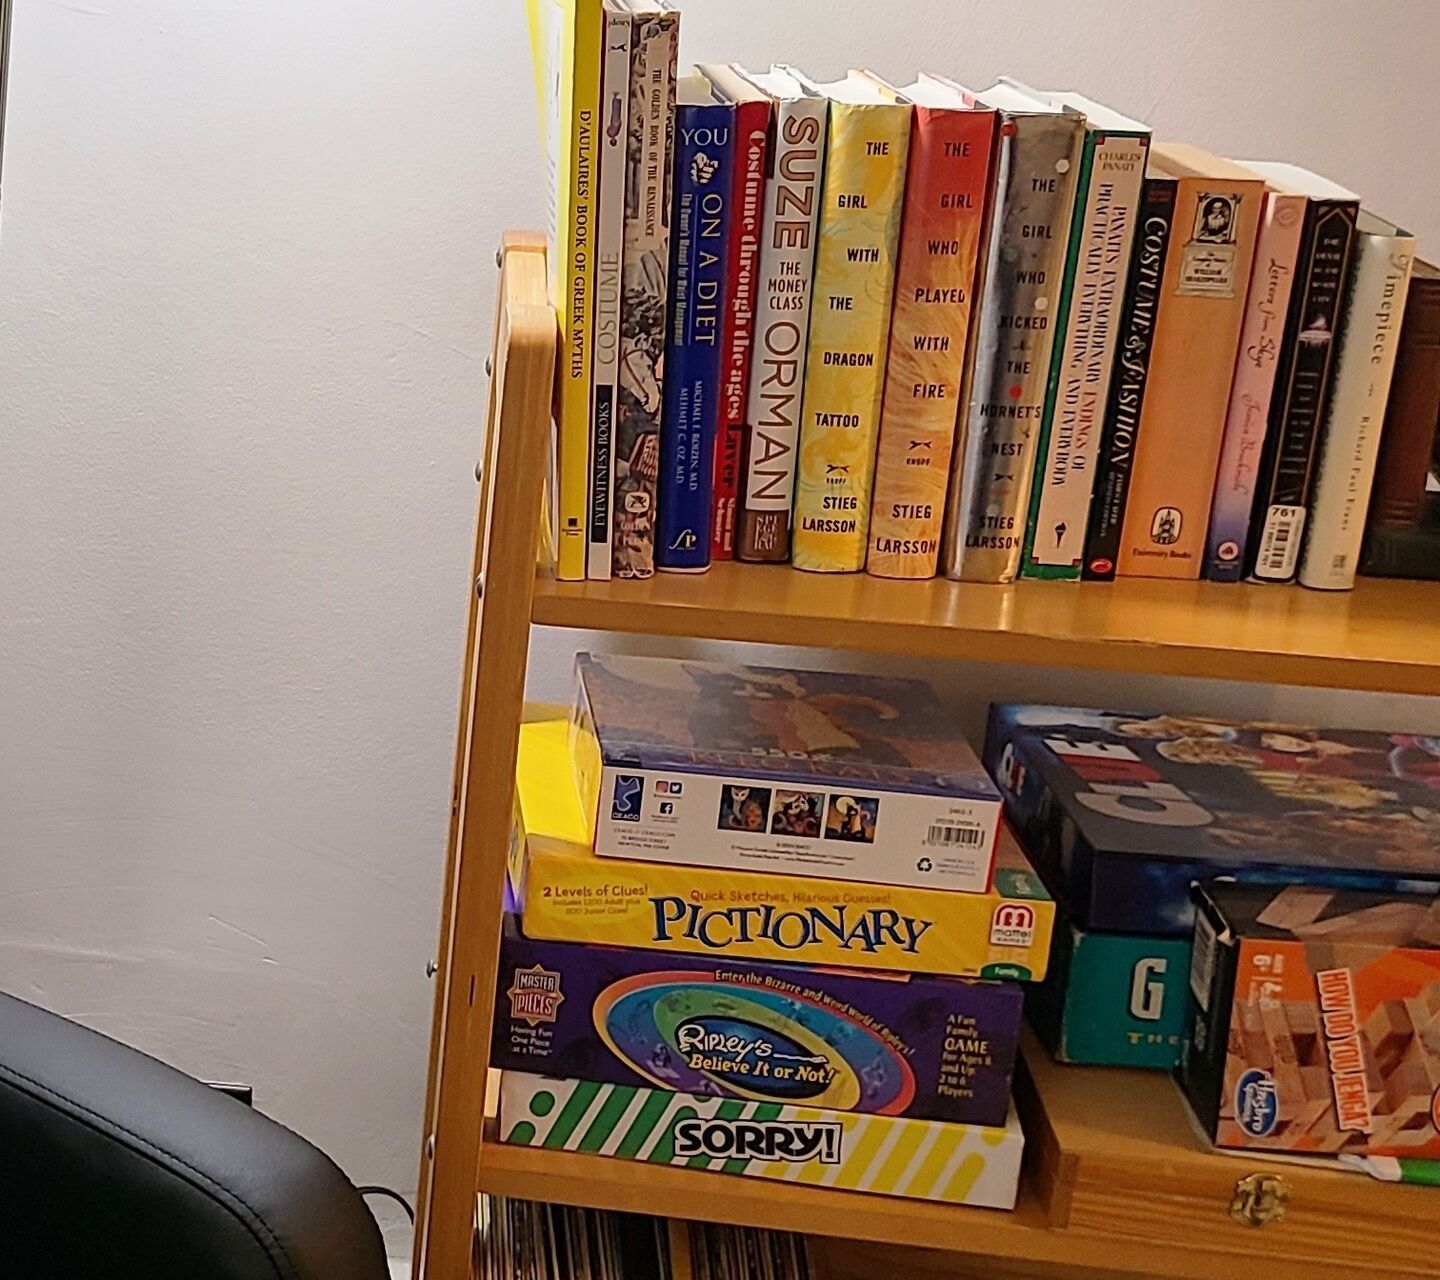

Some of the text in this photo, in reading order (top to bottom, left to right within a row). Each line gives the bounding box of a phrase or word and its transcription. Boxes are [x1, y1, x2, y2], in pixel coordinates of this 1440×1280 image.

[651, 68, 662, 83] THE
[650, 89, 661, 120] GOLDEN
[649, 125, 659, 147] BOOK
[681, 128, 728, 146] YOU
[648, 151, 657, 162] OF
[866, 142, 890, 156] THE
[944, 142, 971, 157] THE
[1098, 151, 1142, 162] CHARLES
[647, 165, 658, 181] THE
[772, 115, 820, 249] SUZE
[1031, 178, 1056, 193] THE
[838, 195, 868, 209] GIRL
[940, 194, 973, 208] GIRL
[1022, 225, 1052, 239] GIRL
[571, 110, 591, 379] D'AULAIRES' BOOK OF GREEK MYTHS
[928, 240, 959, 256] WHO
[847, 248, 879, 262] WITH
[695, 194, 723, 346] ON A DIET
[726, 131, 767, 419] Costume through the ages
[779, 262, 801, 276] THE
[1131, 217, 1168, 334] COSTUME
[1016, 271, 1046, 285] WHO
[1266, 258, 1289, 304] Letters
[768, 279, 808, 293] MONEY
[769, 296, 804, 310] CLASS
[829, 296, 853, 310] THE
[915, 288, 966, 303] PLAYED
[597, 253, 619, 365] COSTUME
[1371, 253, 1410, 365] Timepiece
[999, 315, 1048, 330] KICKED
[1085, 271, 1117, 382] EXTRAORDINARY
[1051, 183, 1114, 486] PRACTICALLY EVERYTHING AND EVERYBODY
[913, 336, 950, 351] WITH
[1124, 334, 1147, 354] &
[823, 352, 874, 367] DRAGON
[1247, 336, 1276, 368] Skye
[1007, 361, 1031, 374] THE
[913, 384, 946, 398] FIRE
[751, 321, 801, 500] ORMAN
[980, 404, 1042, 419] HORNET'S
[1110, 351, 1146, 468] FASHION
[815, 413, 859, 428] TATTOO
[1075, 391, 1097, 449] ENDINGS
[991, 443, 1024, 456] NEST
[594, 401, 609, 526] EYEWITNESS BOOKS
[1071, 455, 1086, 470] OF
[823, 496, 858, 510] STIEG
[892, 504, 932, 519] STIEG
[1272, 508, 1296, 517] 761
[802, 517, 856, 533] LARSSON
[979, 516, 1014, 529] STIEG
[876, 536, 937, 554] LARSSON
[965, 534, 1020, 549] LARSSON
[543, 884, 649, 898] 2 Levels of Clues!
[690, 890, 892, 904] Quick Sketches, Hilarious Guesses!
[648, 896, 933, 954] PICTIONARY
[993, 929, 1032, 937] mattel
[520, 974, 555, 992] MASTER
[714, 969, 744, 983] Enter
[746, 972, 761, 985] the
[765, 975, 801, 995] Bizarre
[803, 987, 823, 1002] and
[1320, 971, 1351, 1011] HOW
[517, 993, 553, 1015] PIECES
[1325, 1012, 1357, 1037] DO
[511, 1035, 528, 1045] One
[538, 1028, 553, 1038] Fun
[678, 1024, 774, 1063] Ripley's
[944, 1037, 989, 1054] GAME
[1330, 1037, 1361, 1071] YOU
[689, 1053, 836, 1084] Believe It or Not!
[1251, 1078, 1276, 1133] Hasbro
[678, 1122, 836, 1160] SORRY!
